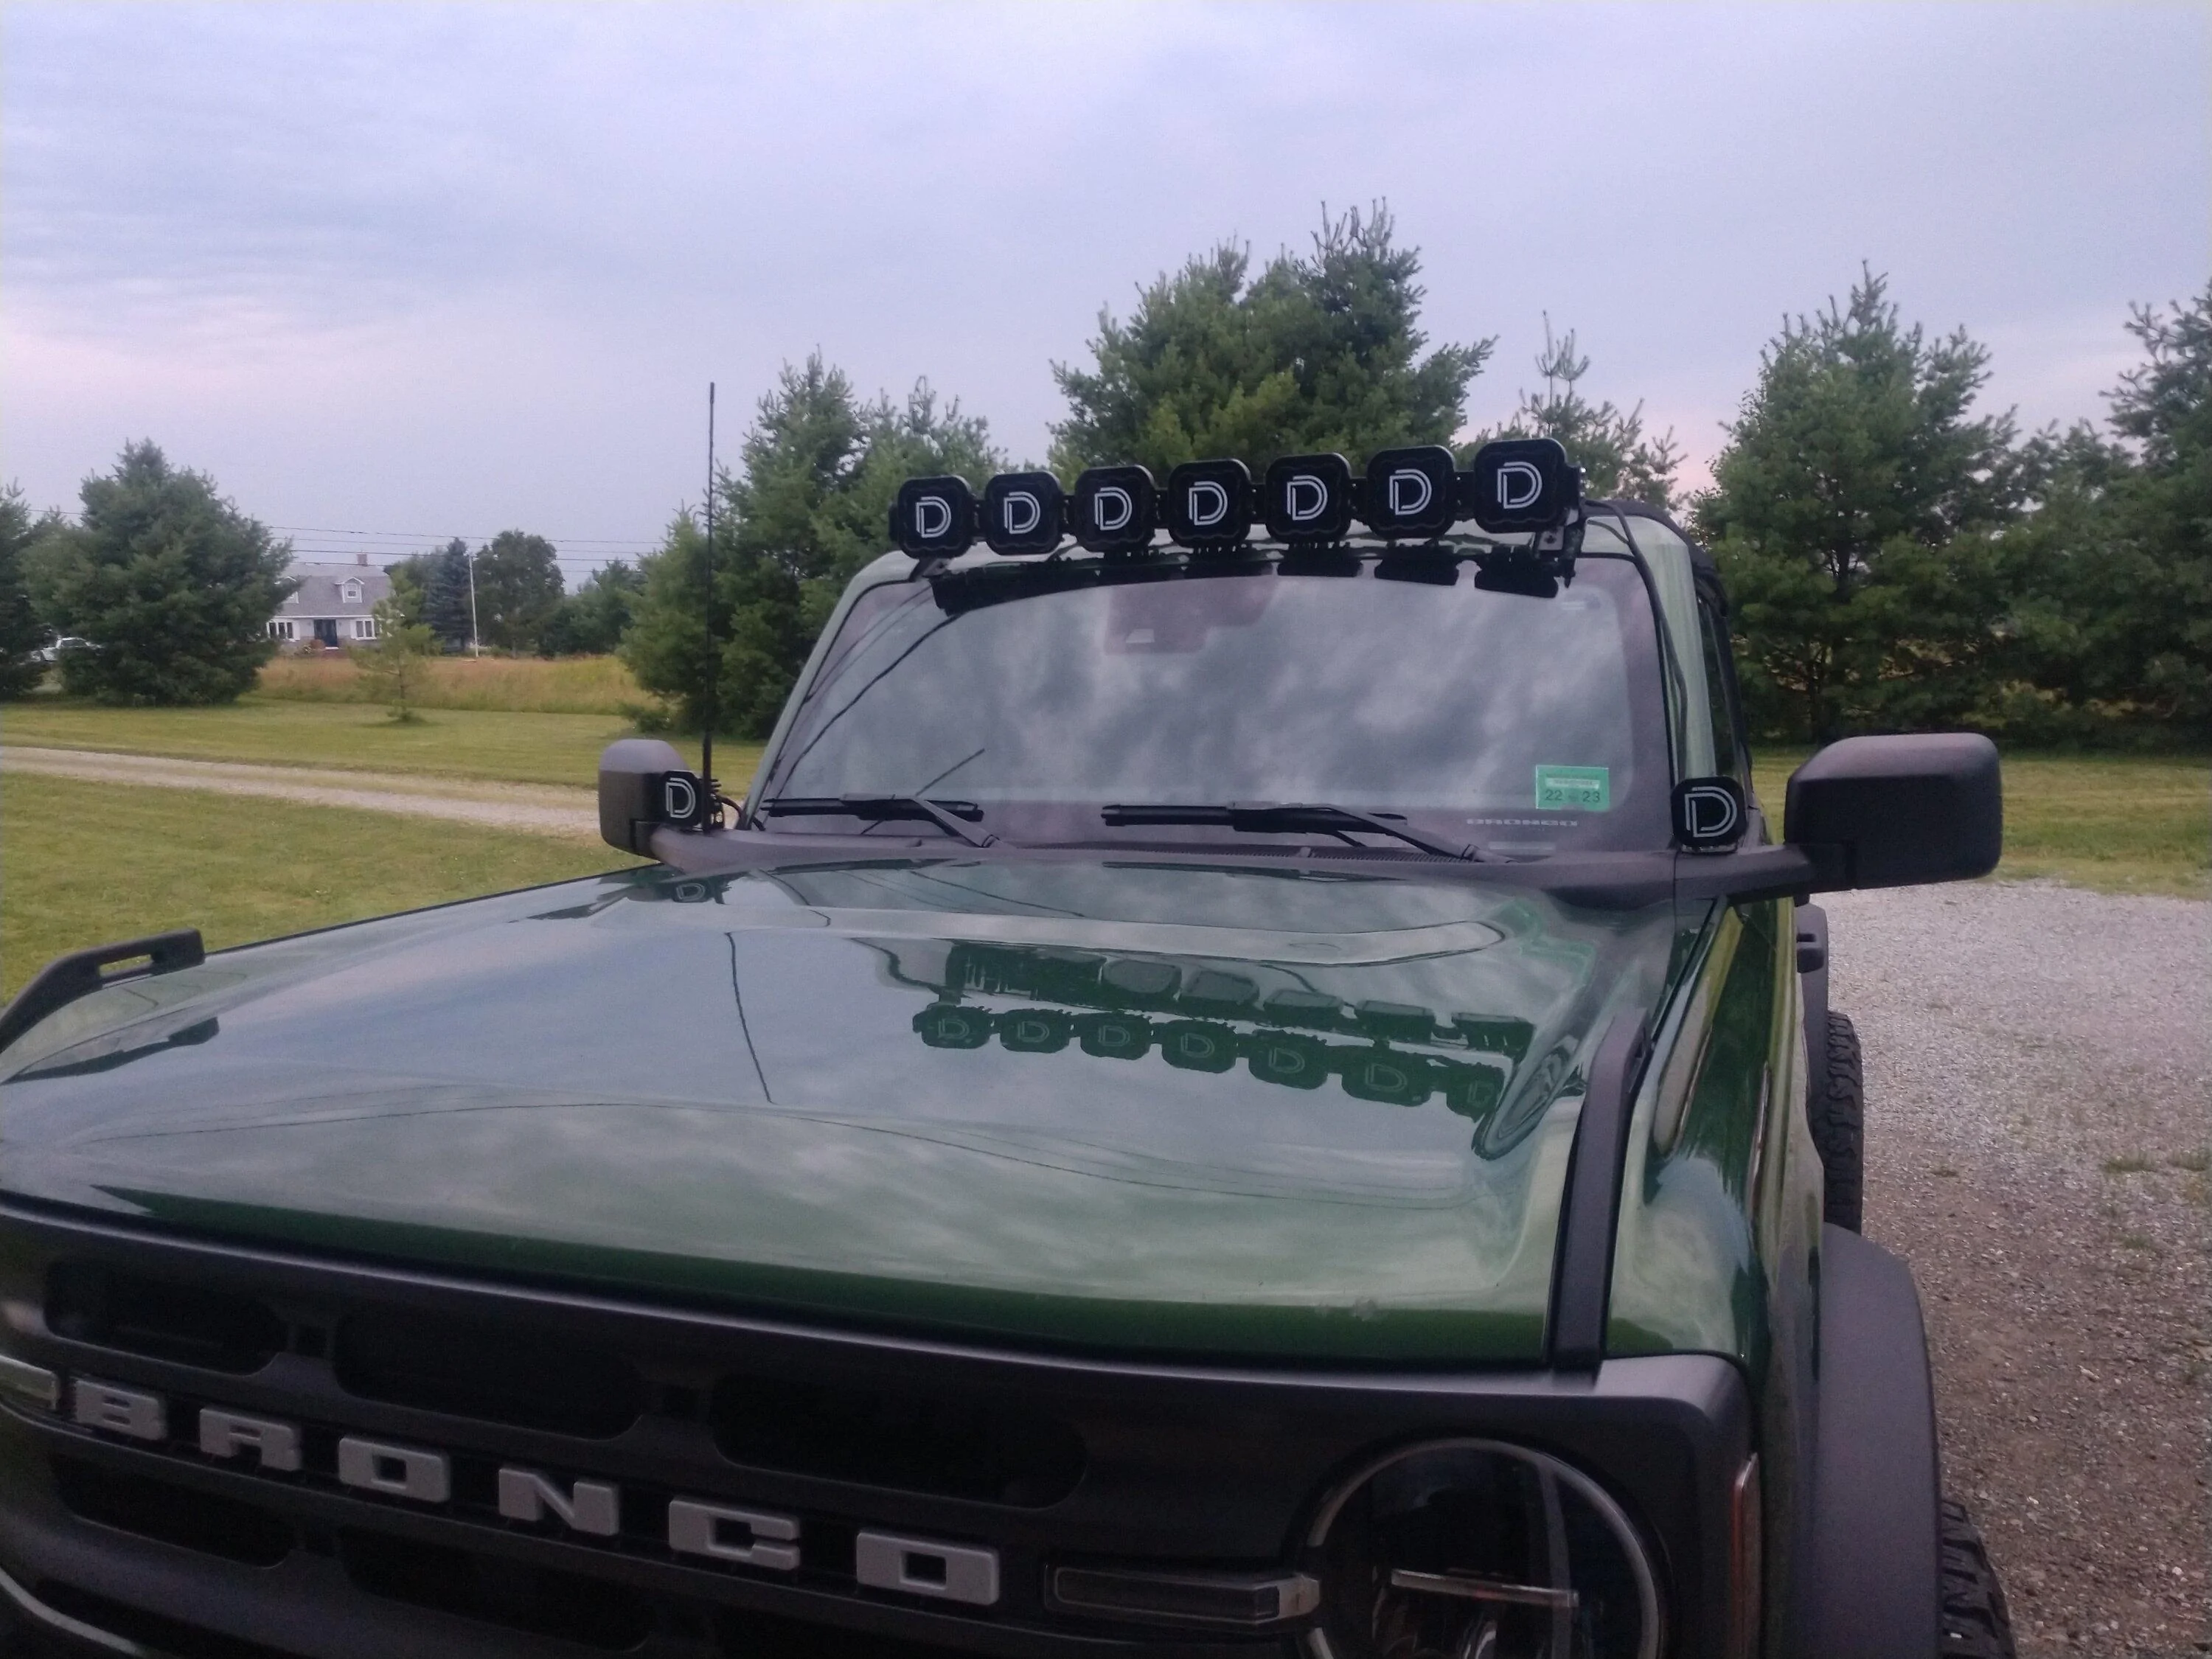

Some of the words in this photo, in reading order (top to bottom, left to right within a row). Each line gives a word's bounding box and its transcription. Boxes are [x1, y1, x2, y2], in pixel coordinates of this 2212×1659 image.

[1189, 481, 1228, 526] D
[1287, 475, 1328, 521] D
[1389, 469, 1432, 515] D
[1497, 462, 1543, 509] D
[916, 496, 952, 538] D
[1004, 491, 1041, 535] D
[1094, 487, 1133, 531] D
[666, 777, 696, 818] D
[1545, 789, 1562, 801] 22
[1582, 791, 1600, 802] 23
[1684, 786, 1737, 838] D
[75, 1379, 1001, 1606] BRONCO
